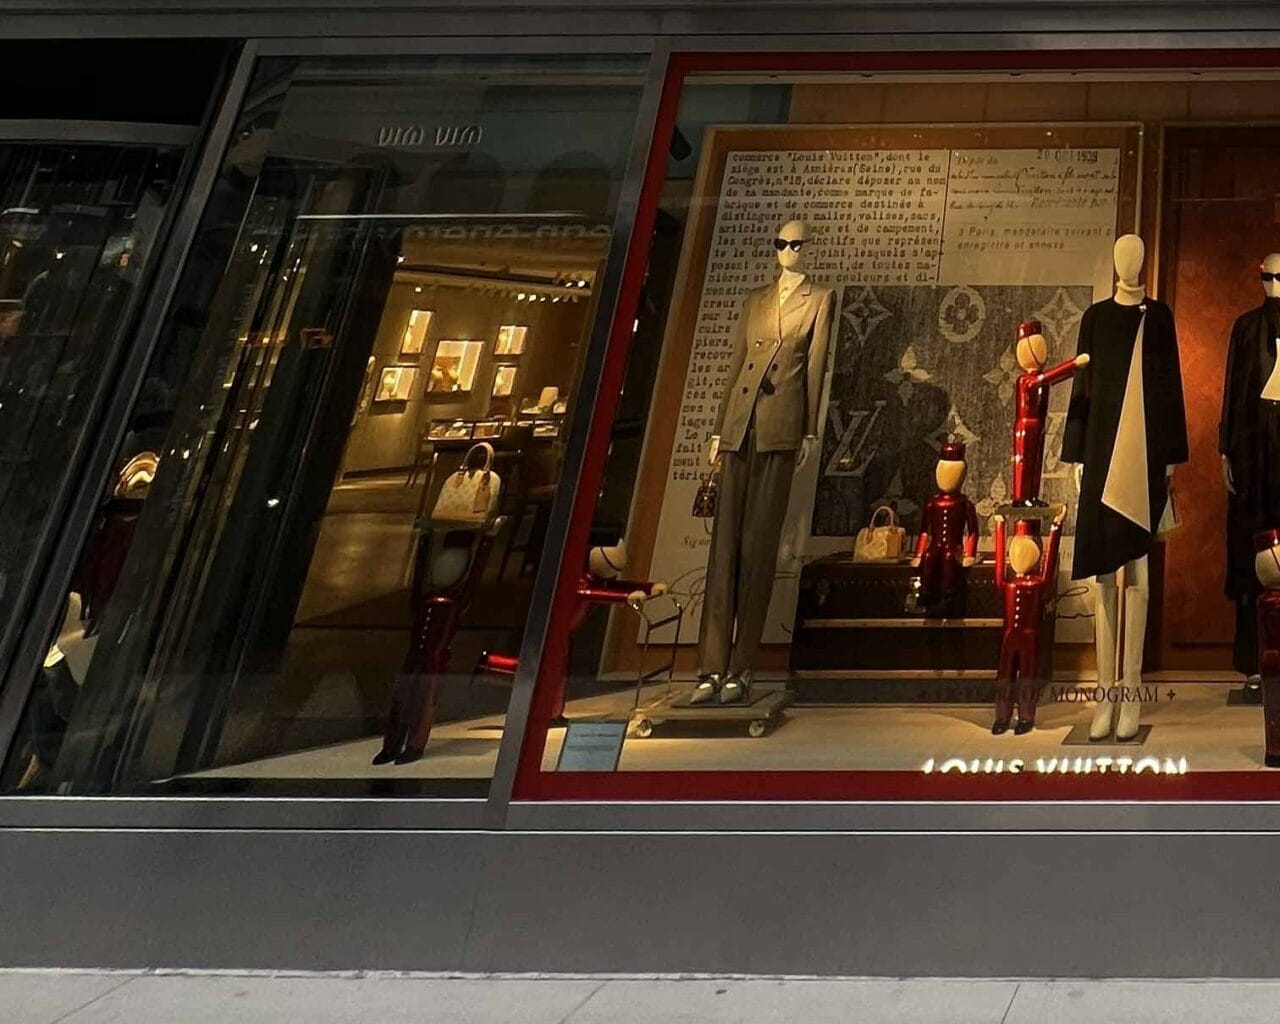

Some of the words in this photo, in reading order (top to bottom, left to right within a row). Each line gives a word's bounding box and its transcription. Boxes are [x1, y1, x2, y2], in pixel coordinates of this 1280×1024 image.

[918, 152, 930, 161] le
[766, 165, 784, 174] est
[928, 163, 941, 174] du
[726, 188, 738, 197] de
[900, 187, 912, 197] de
[766, 201, 778, 209] et
[785, 200, 798, 209] de
[837, 224, 850, 233] et
[856, 223, 869, 233] de
[861, 237, 881, 248] que
[734, 248, 745, 257] le
[896, 273, 908, 282] et
[1049, 687, 1159, 704] MONOGRAM
